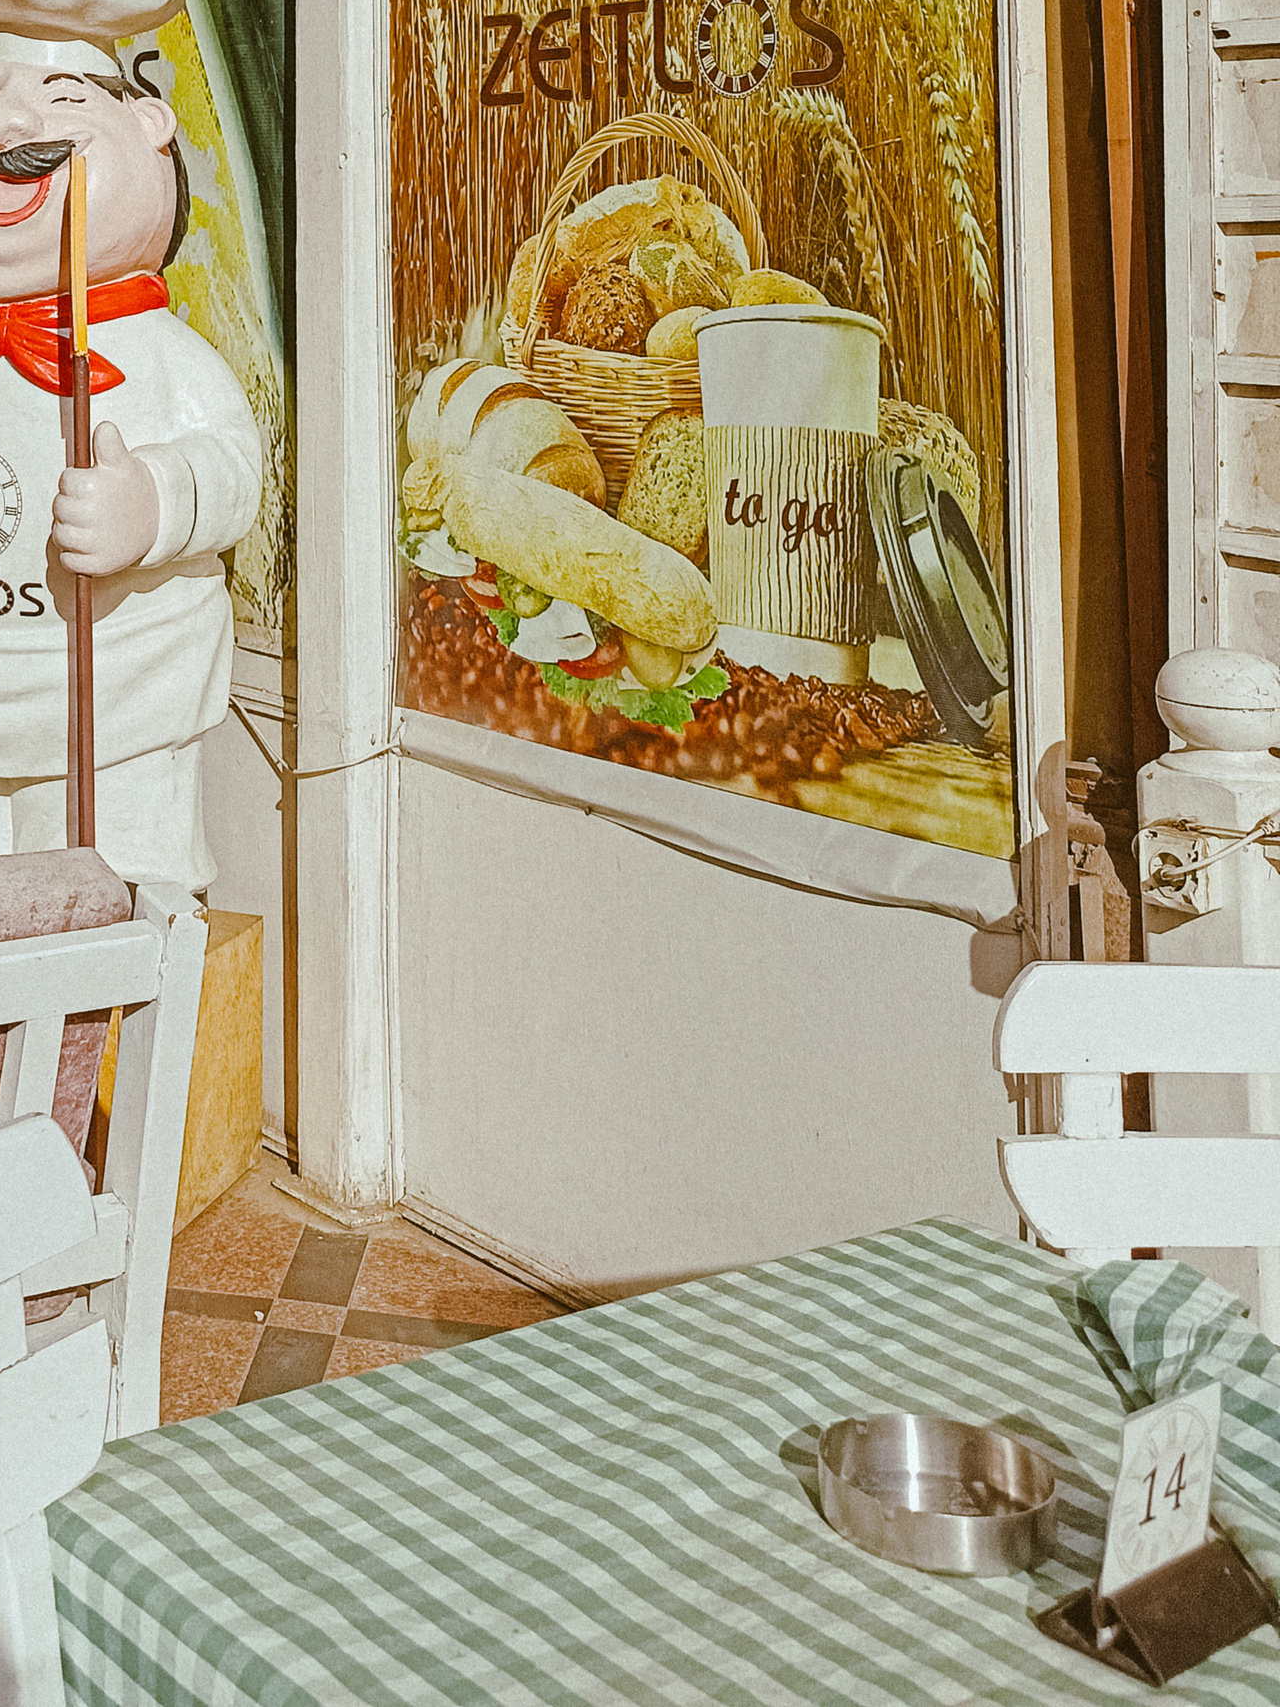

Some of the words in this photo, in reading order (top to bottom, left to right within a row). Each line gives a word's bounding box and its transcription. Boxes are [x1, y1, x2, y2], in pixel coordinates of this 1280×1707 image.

[725, 478, 767, 528] to
[782, 498, 843, 553] go
[1138, 1452, 1187, 1527] 14
